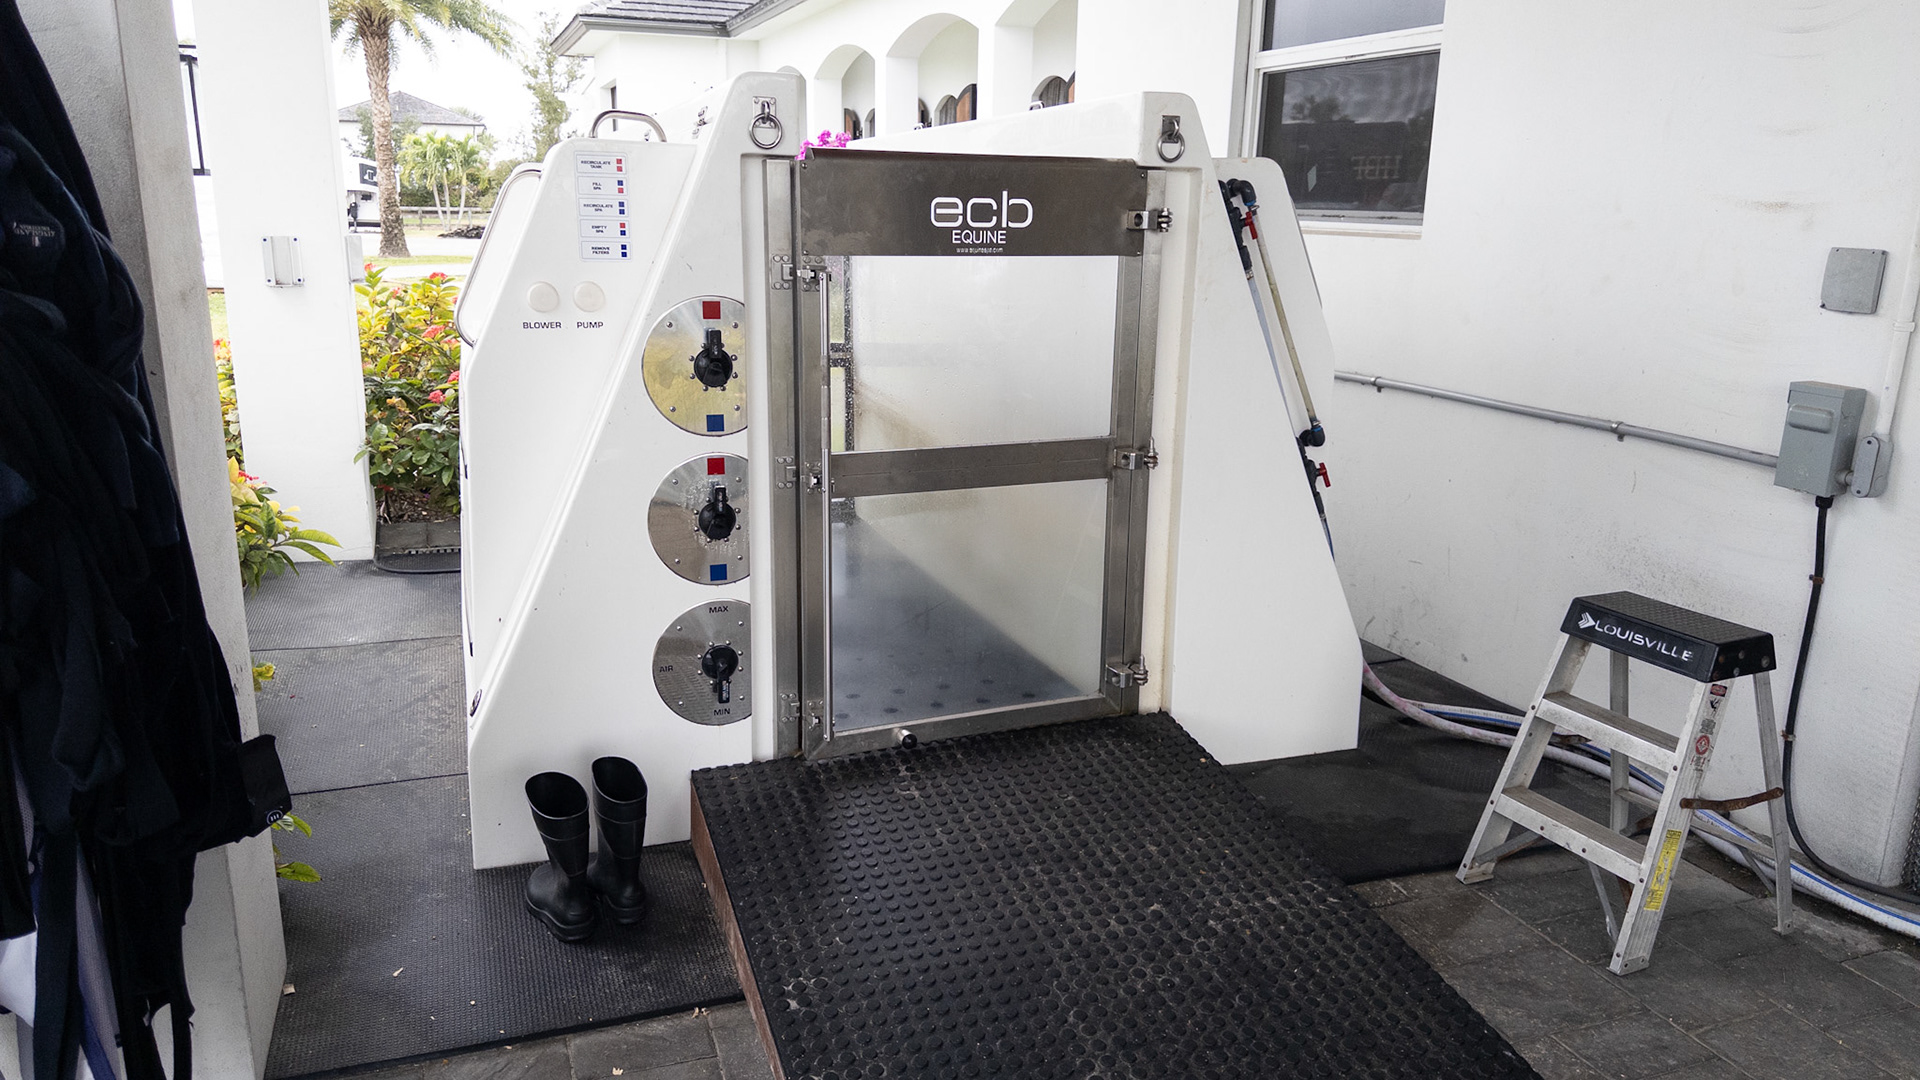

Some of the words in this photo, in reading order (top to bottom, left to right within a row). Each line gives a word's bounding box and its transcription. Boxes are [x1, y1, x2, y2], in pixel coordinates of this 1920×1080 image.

[930, 190, 1033, 228] ecb
[952, 230, 1007, 244] EQUINE
[522, 321, 562, 329] BLOWER
[576, 321, 604, 329] PUMP
[709, 605, 729, 613] MAX
[1594, 620, 1694, 662] LOUISVILLE
[713, 708, 731, 716] MIN
